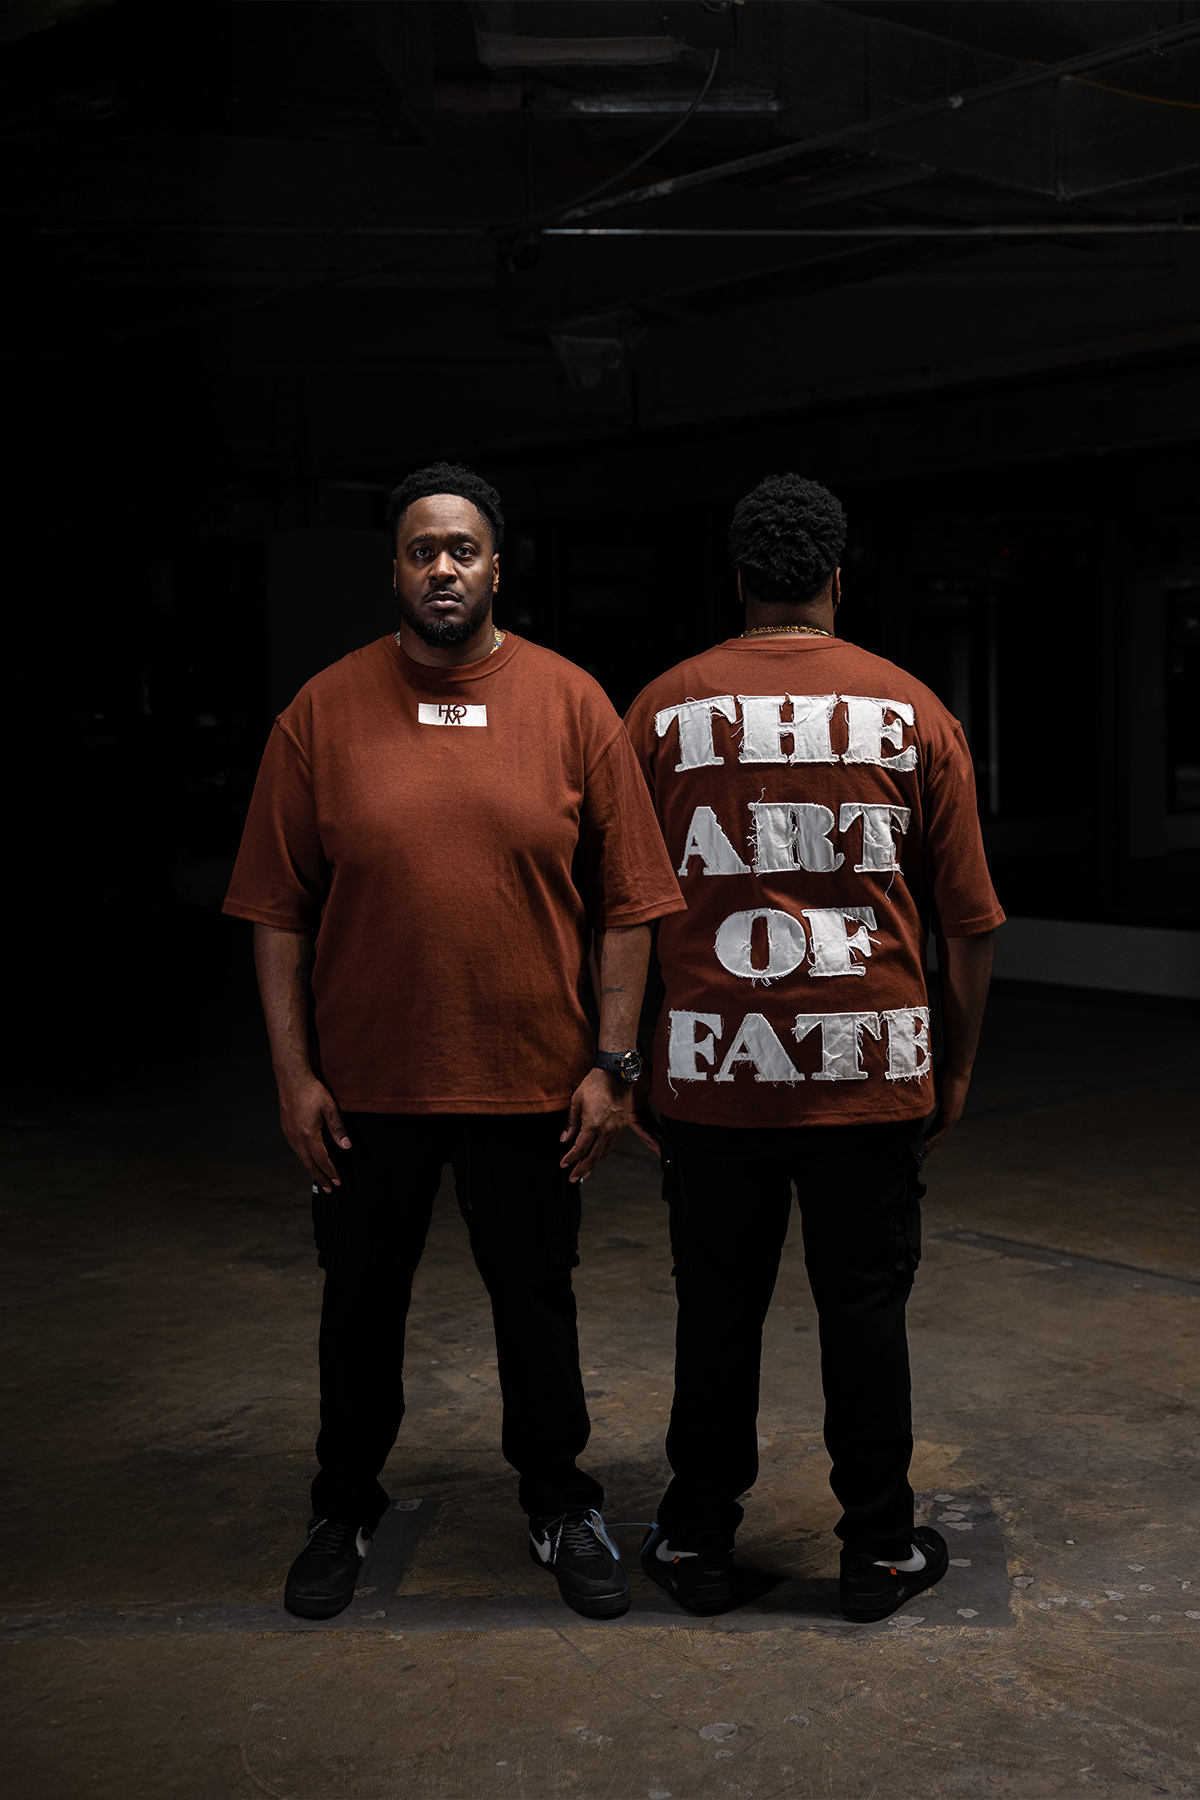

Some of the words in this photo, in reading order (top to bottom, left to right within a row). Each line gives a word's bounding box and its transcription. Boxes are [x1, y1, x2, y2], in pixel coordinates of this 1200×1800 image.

[655, 693, 918, 773] THE
[678, 803, 912, 876] ART
[714, 906, 879, 981] OF
[668, 1006, 931, 1084] FATE
